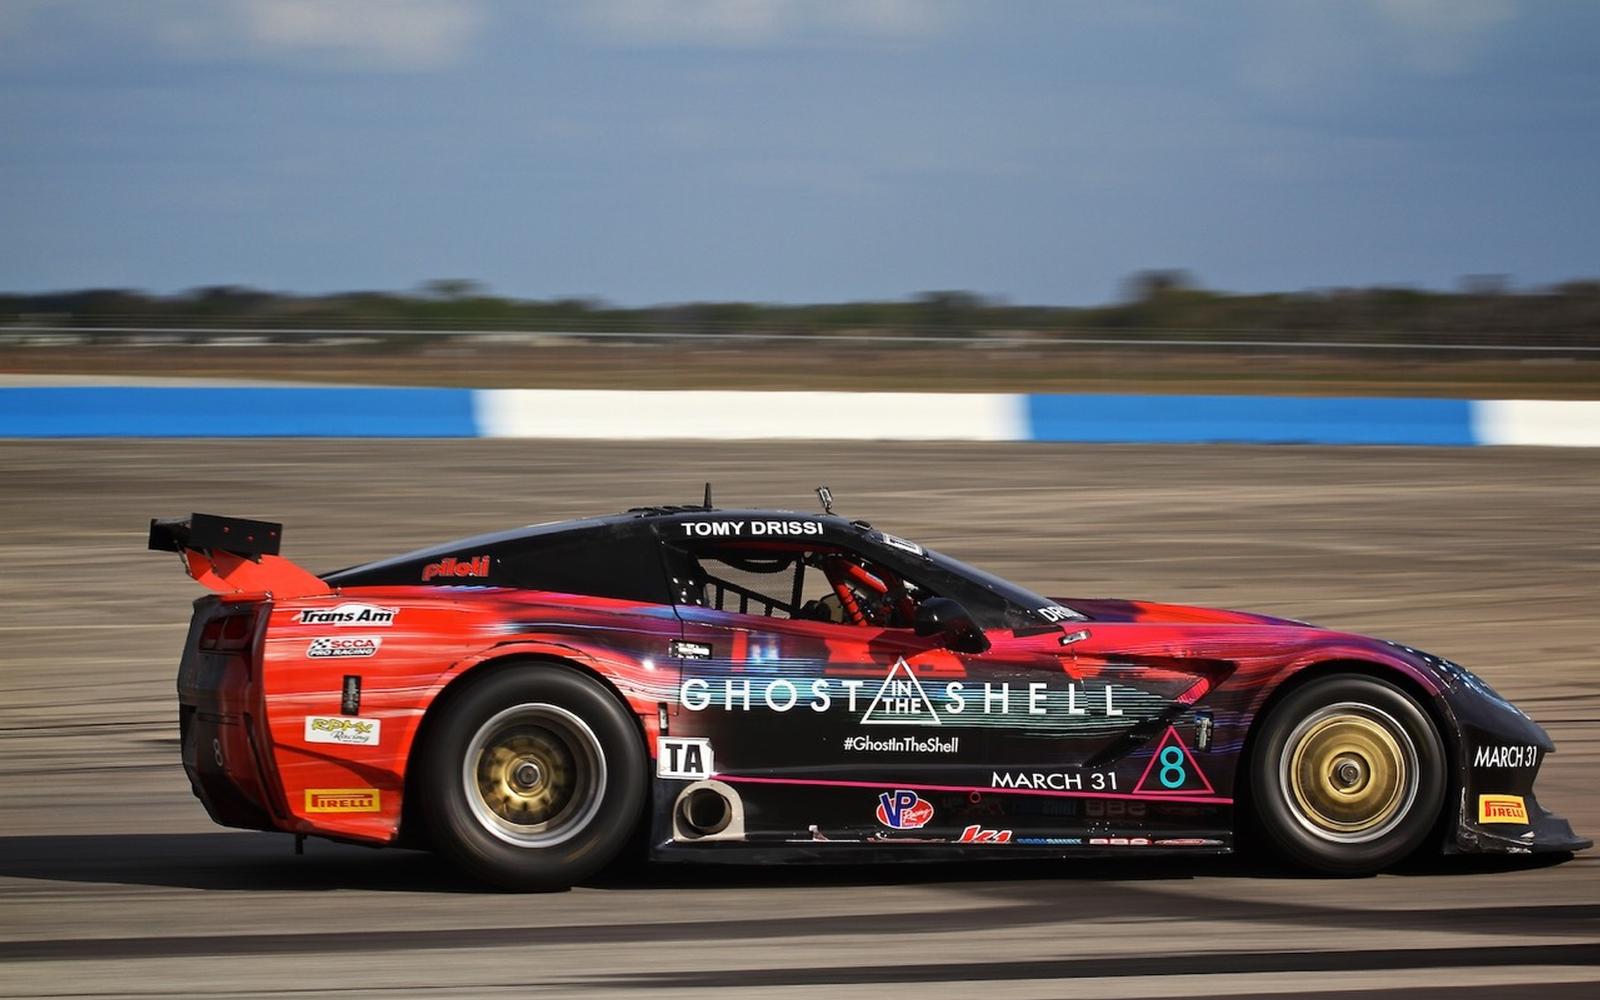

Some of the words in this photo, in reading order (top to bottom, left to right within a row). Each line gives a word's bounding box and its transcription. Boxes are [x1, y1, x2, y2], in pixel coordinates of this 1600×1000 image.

[681, 521, 745, 536] TOMY
[751, 521, 824, 536] DRISSI
[421, 555, 491, 582] piloti
[301, 610, 354, 623] Trans
[356, 609, 392, 622] Am
[330, 639, 375, 648] SCCA
[332, 648, 373, 656] RACING
[680, 679, 864, 712] GHOST
[945, 681, 1124, 716] SHELL
[891, 680, 912, 697] IN
[882, 698, 922, 714] THE
[213, 738, 223, 767] 8
[843, 736, 959, 753] #GhostInTheShell
[665, 743, 704, 774] TA
[1474, 745, 1524, 768] MARCH
[1525, 745, 1538, 767] 31
[1160, 745, 1186, 789] 8
[991, 771, 1083, 790] MARCH
[1091, 771, 1118, 790] 31
[311, 793, 374, 808] PIRELLI
[879, 790, 919, 829] VP
[1484, 800, 1524, 818] PIRELLI
